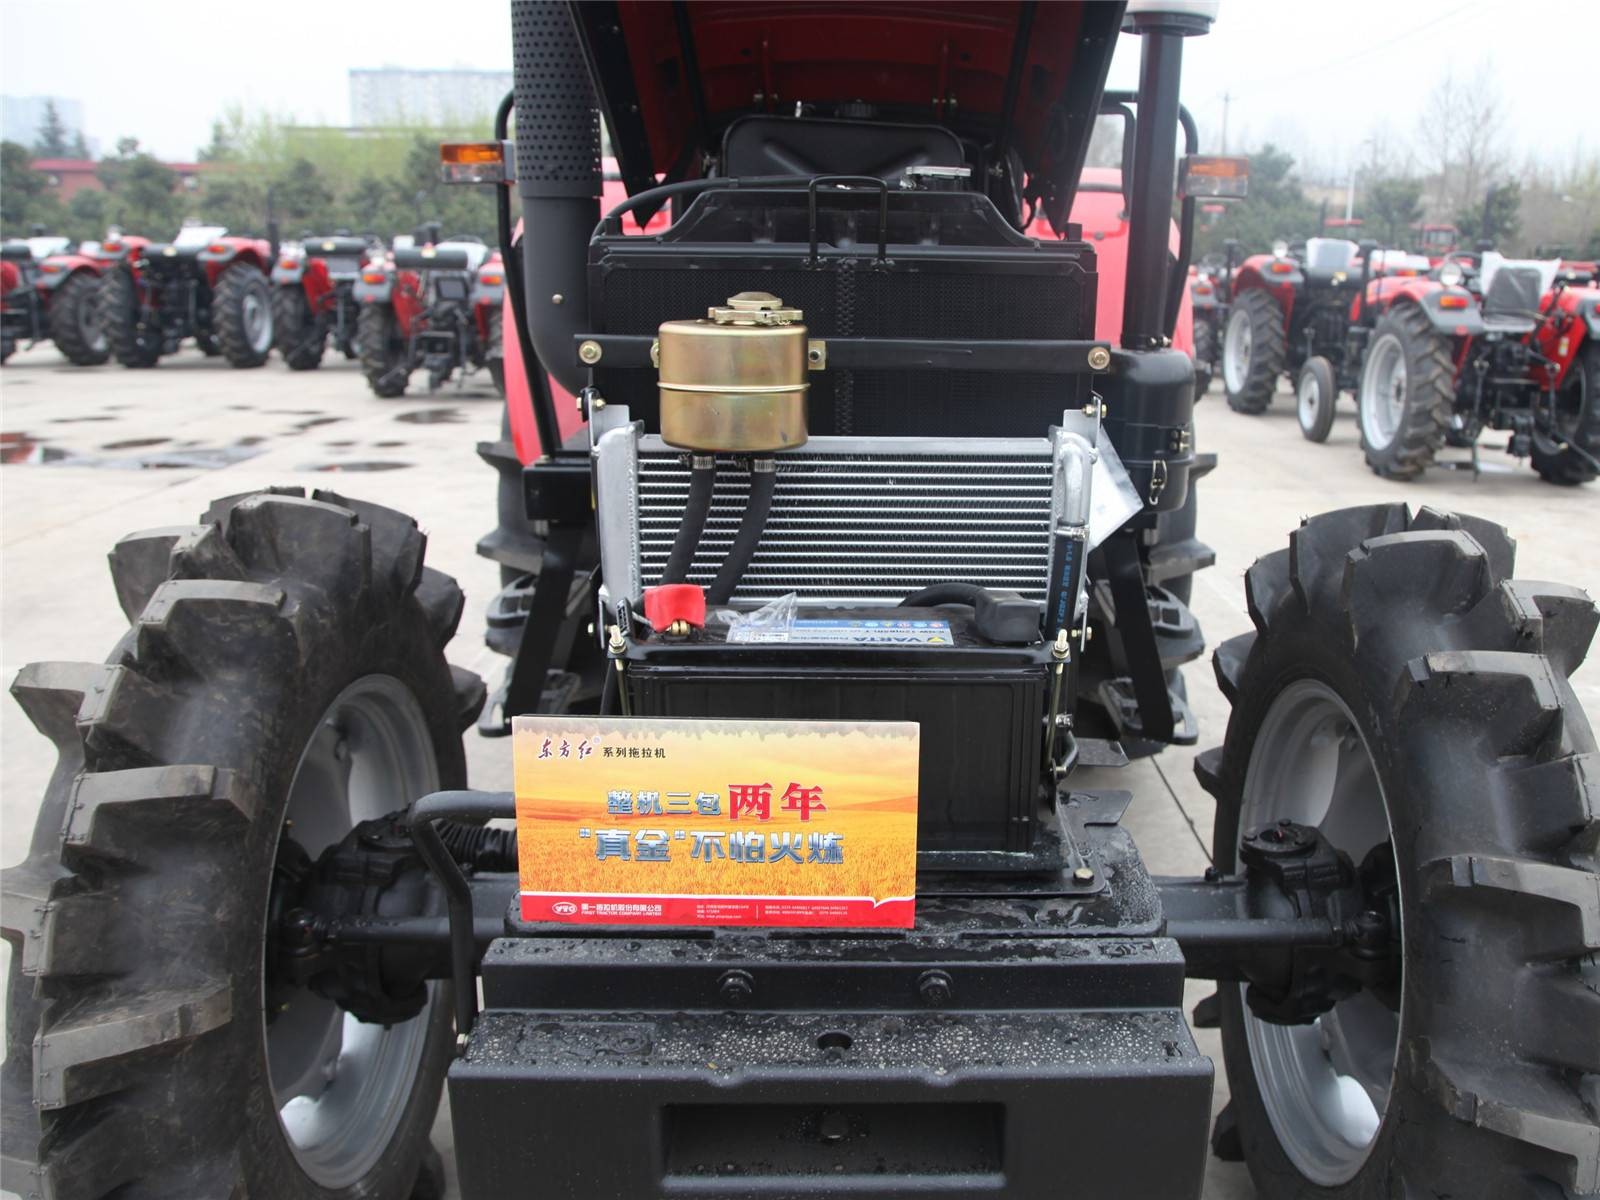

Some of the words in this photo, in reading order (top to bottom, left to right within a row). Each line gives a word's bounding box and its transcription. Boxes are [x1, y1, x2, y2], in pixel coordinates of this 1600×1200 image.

[538, 738, 593, 760] 东方红
[603, 746, 666, 759] 系列拖拉机
